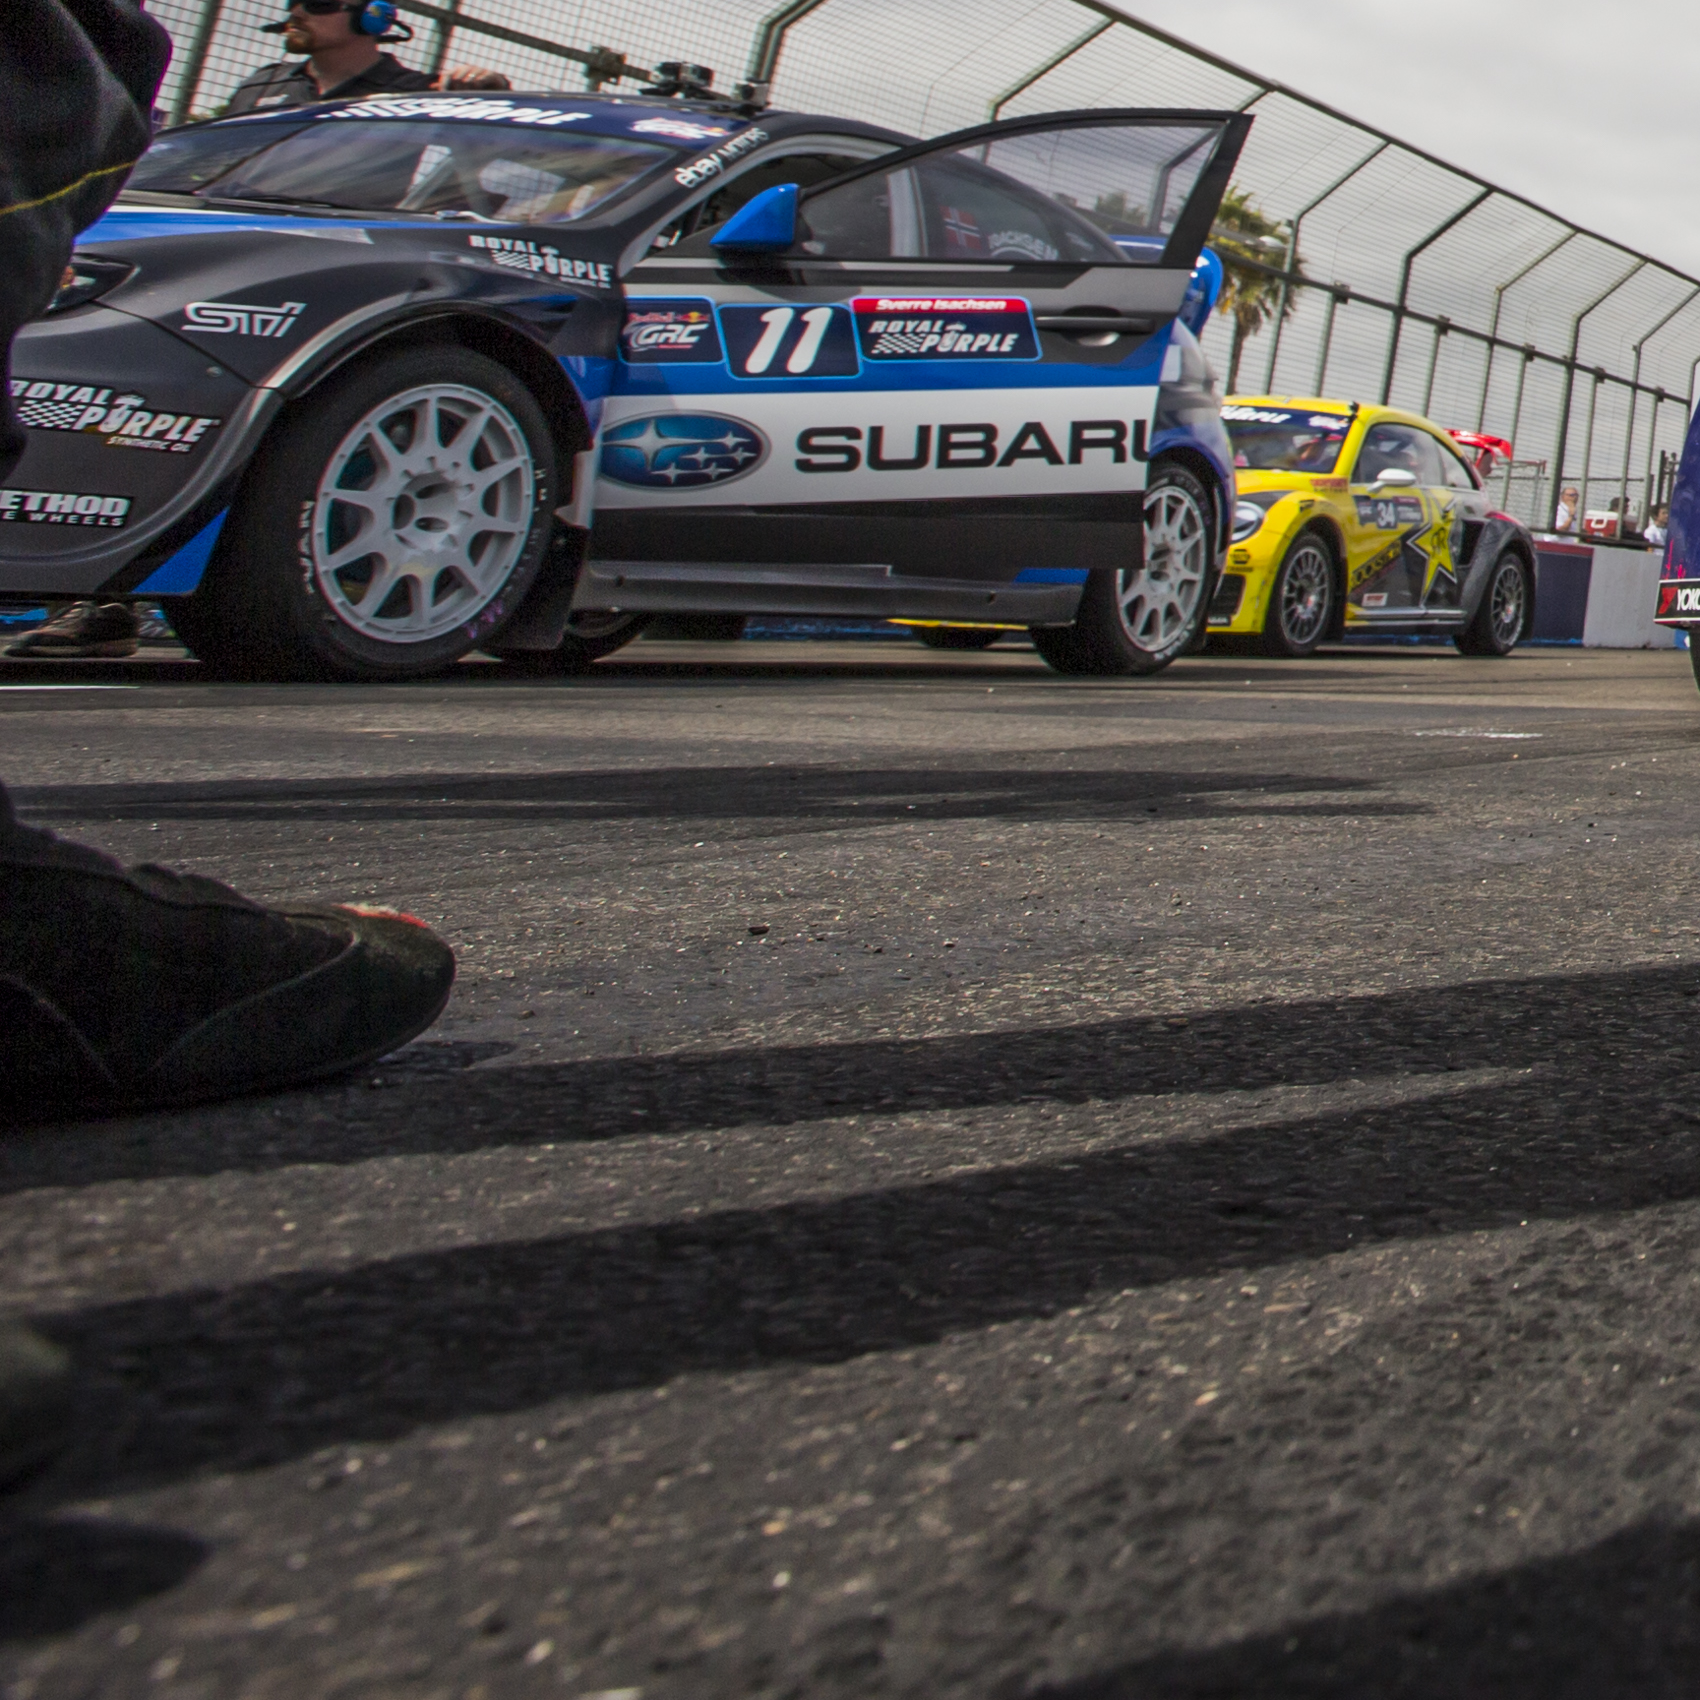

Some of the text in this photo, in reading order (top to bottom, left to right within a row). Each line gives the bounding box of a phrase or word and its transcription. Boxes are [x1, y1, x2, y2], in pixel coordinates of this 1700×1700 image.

[675, 153, 725, 190] ebay
[719, 127, 770, 162] MOTORS
[468, 235, 539, 254] ROYAL
[529, 251, 611, 283] PURPLE
[877, 299, 1006, 311] Sverre Isachsen
[637, 323, 709, 346] GRC
[869, 320, 944, 334] ROYAL
[745, 307, 832, 375] 11
[920, 334, 1020, 353] PURPLE
[73, 405, 210, 443] PURPLE
[0, 490, 131, 518] ETHOD
[1377, 502, 1396, 527] 34
[30, 512, 124, 527] WHEELS
